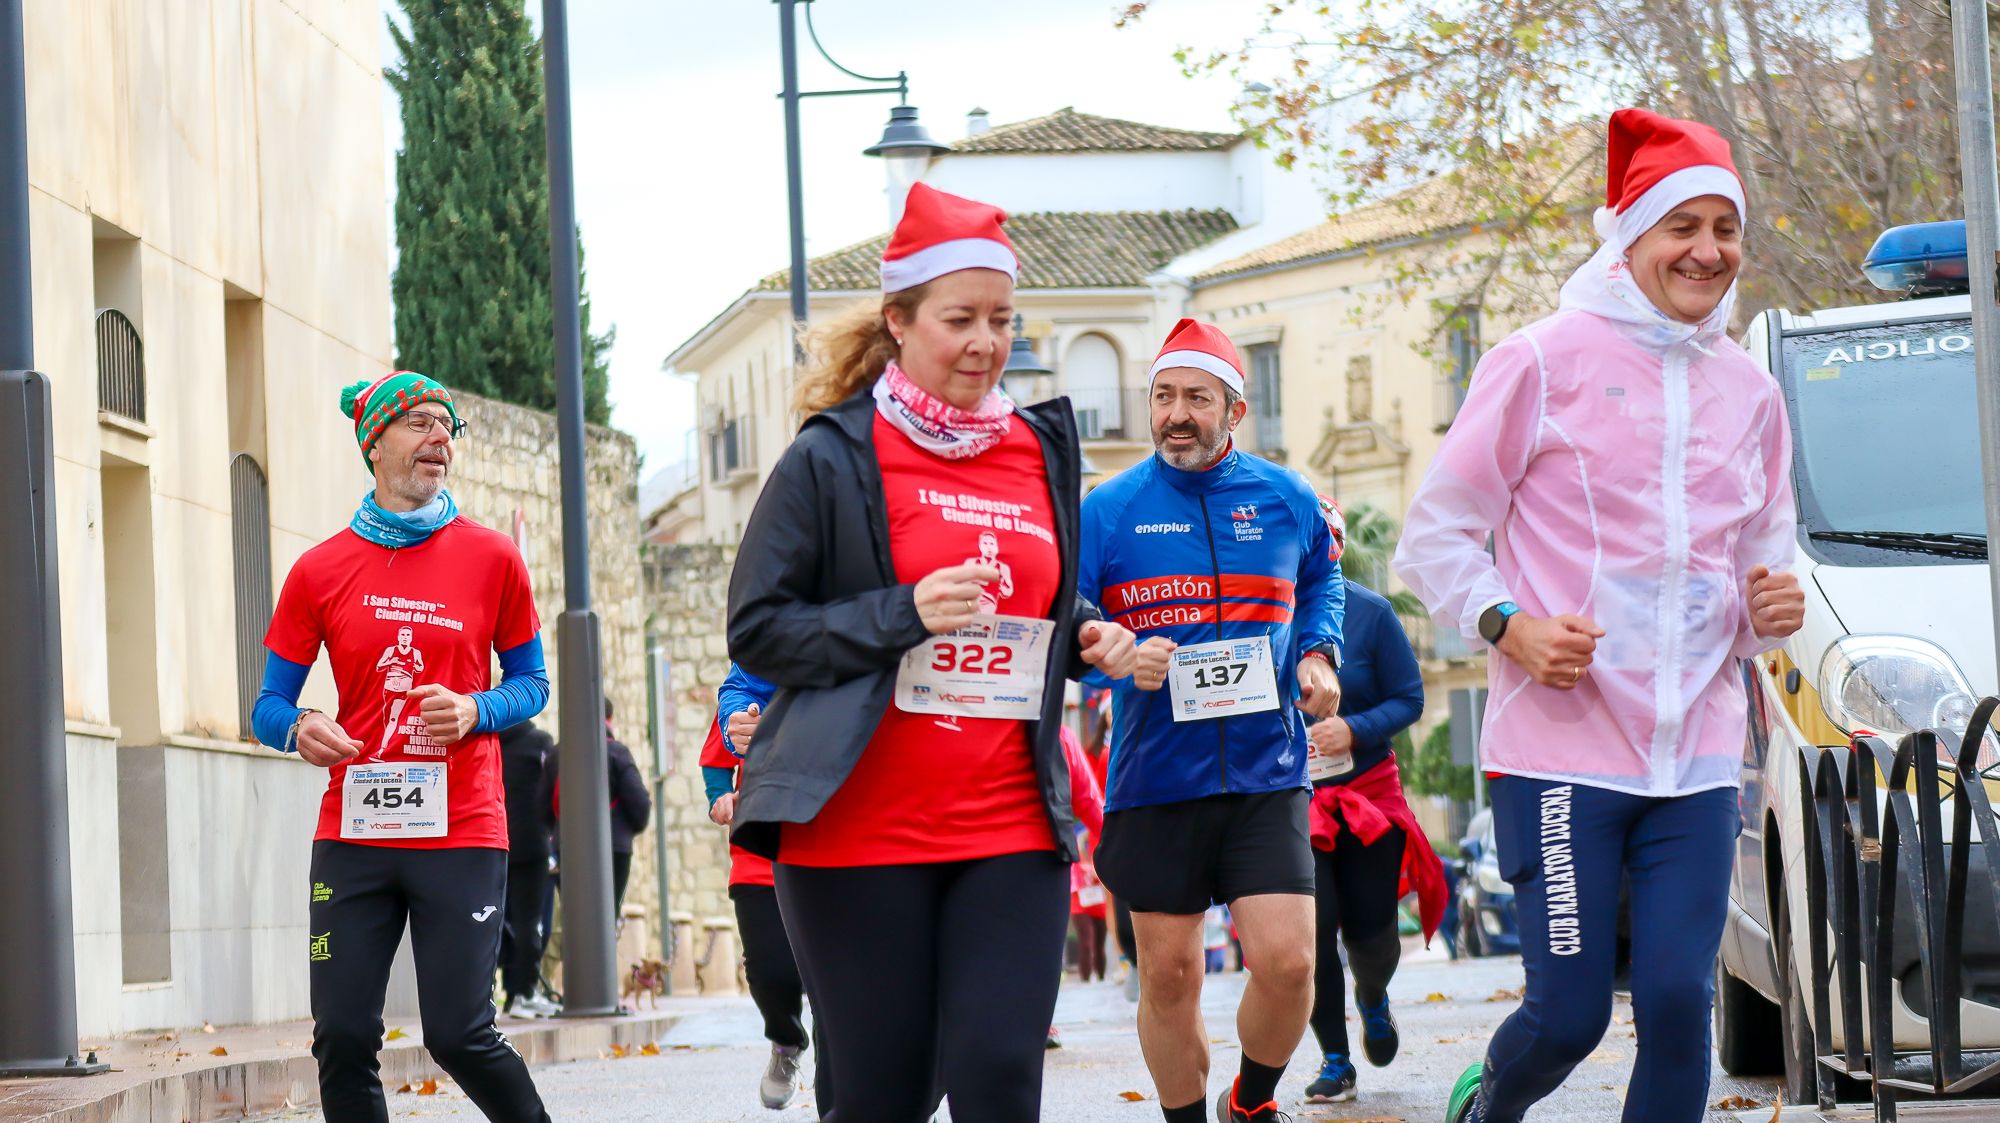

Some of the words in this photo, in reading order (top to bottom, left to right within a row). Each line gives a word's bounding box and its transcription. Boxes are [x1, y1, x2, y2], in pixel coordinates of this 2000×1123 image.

[918, 489, 928, 504] I
[928, 490, 957, 507] San
[957, 494, 1022, 516] Silvestre
[942, 507, 993, 527] Ciudad
[993, 514, 1012, 531] de
[1013, 517, 1054, 545] Lucena
[1135, 522, 1192, 534] enerplus
[1233, 521, 1251, 529] Club
[1235, 526, 1264, 534] Maratón
[1236, 533, 1263, 542] Lucena
[1121, 576, 1212, 608] Maratón
[363, 594, 369, 606] I
[370, 595, 390, 607] San
[390, 596, 437, 612] Silvestre
[375, 607, 412, 622] Ciudad
[412, 611, 427, 624] de
[427, 613, 464, 632] Lucena
[1127, 604, 1201, 631] Lucena
[931, 642, 1013, 675] 322
[1178, 659, 1200, 667] Ciudad
[1194, 662, 1248, 689] 137
[398, 725, 416, 735] JOSE
[403, 744, 447, 757] MARJALIZO
[366, 771, 390, 779] Silvestre
[363, 787, 424, 808] 454
[1540, 785, 1573, 844] LUCENA
[1541, 842, 1579, 916] MARATON
[311, 937, 328, 955] efi
[1549, 917, 1582, 956] CLUB
